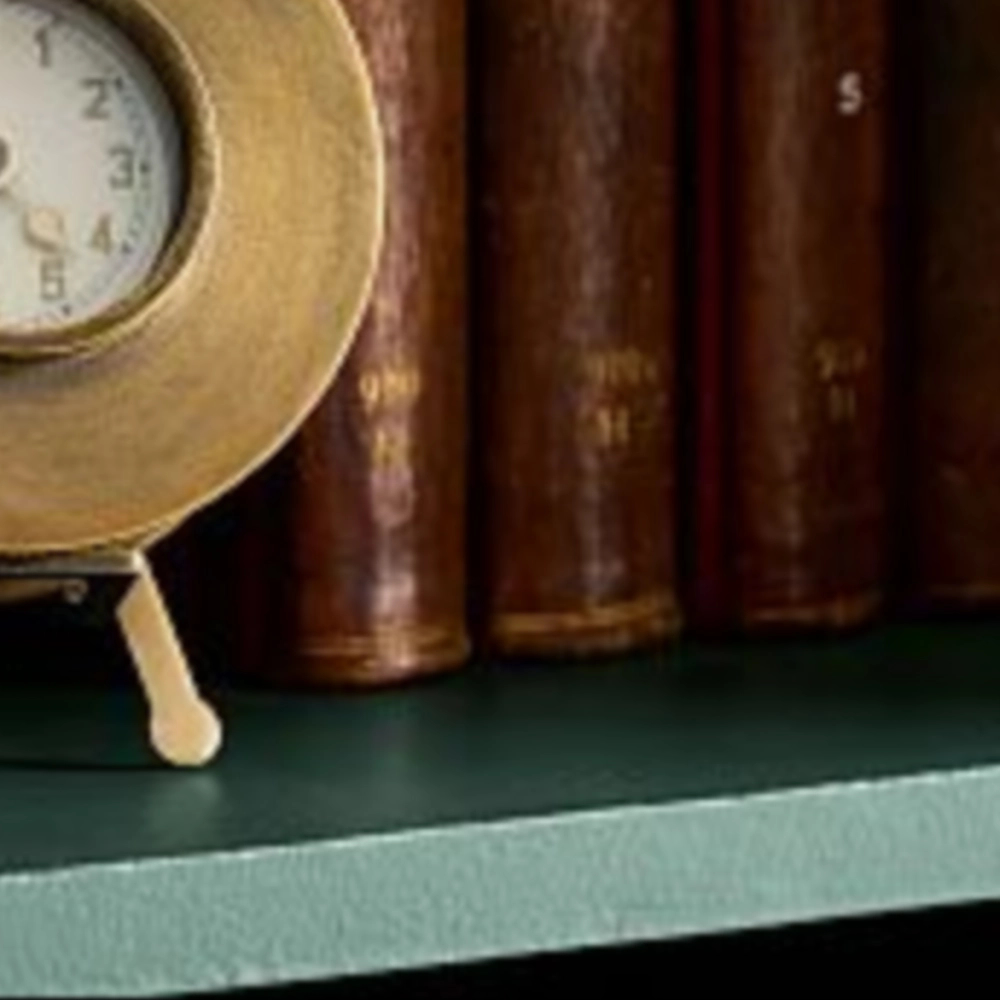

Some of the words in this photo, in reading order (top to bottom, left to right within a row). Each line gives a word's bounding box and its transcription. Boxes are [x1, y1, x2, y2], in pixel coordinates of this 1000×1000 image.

[34, 25, 52, 67] 1
[81, 77, 112, 121] 2
[108, 146, 136, 190] 3
[90, 213, 112, 256] 4
[39, 257, 66, 301] 5
